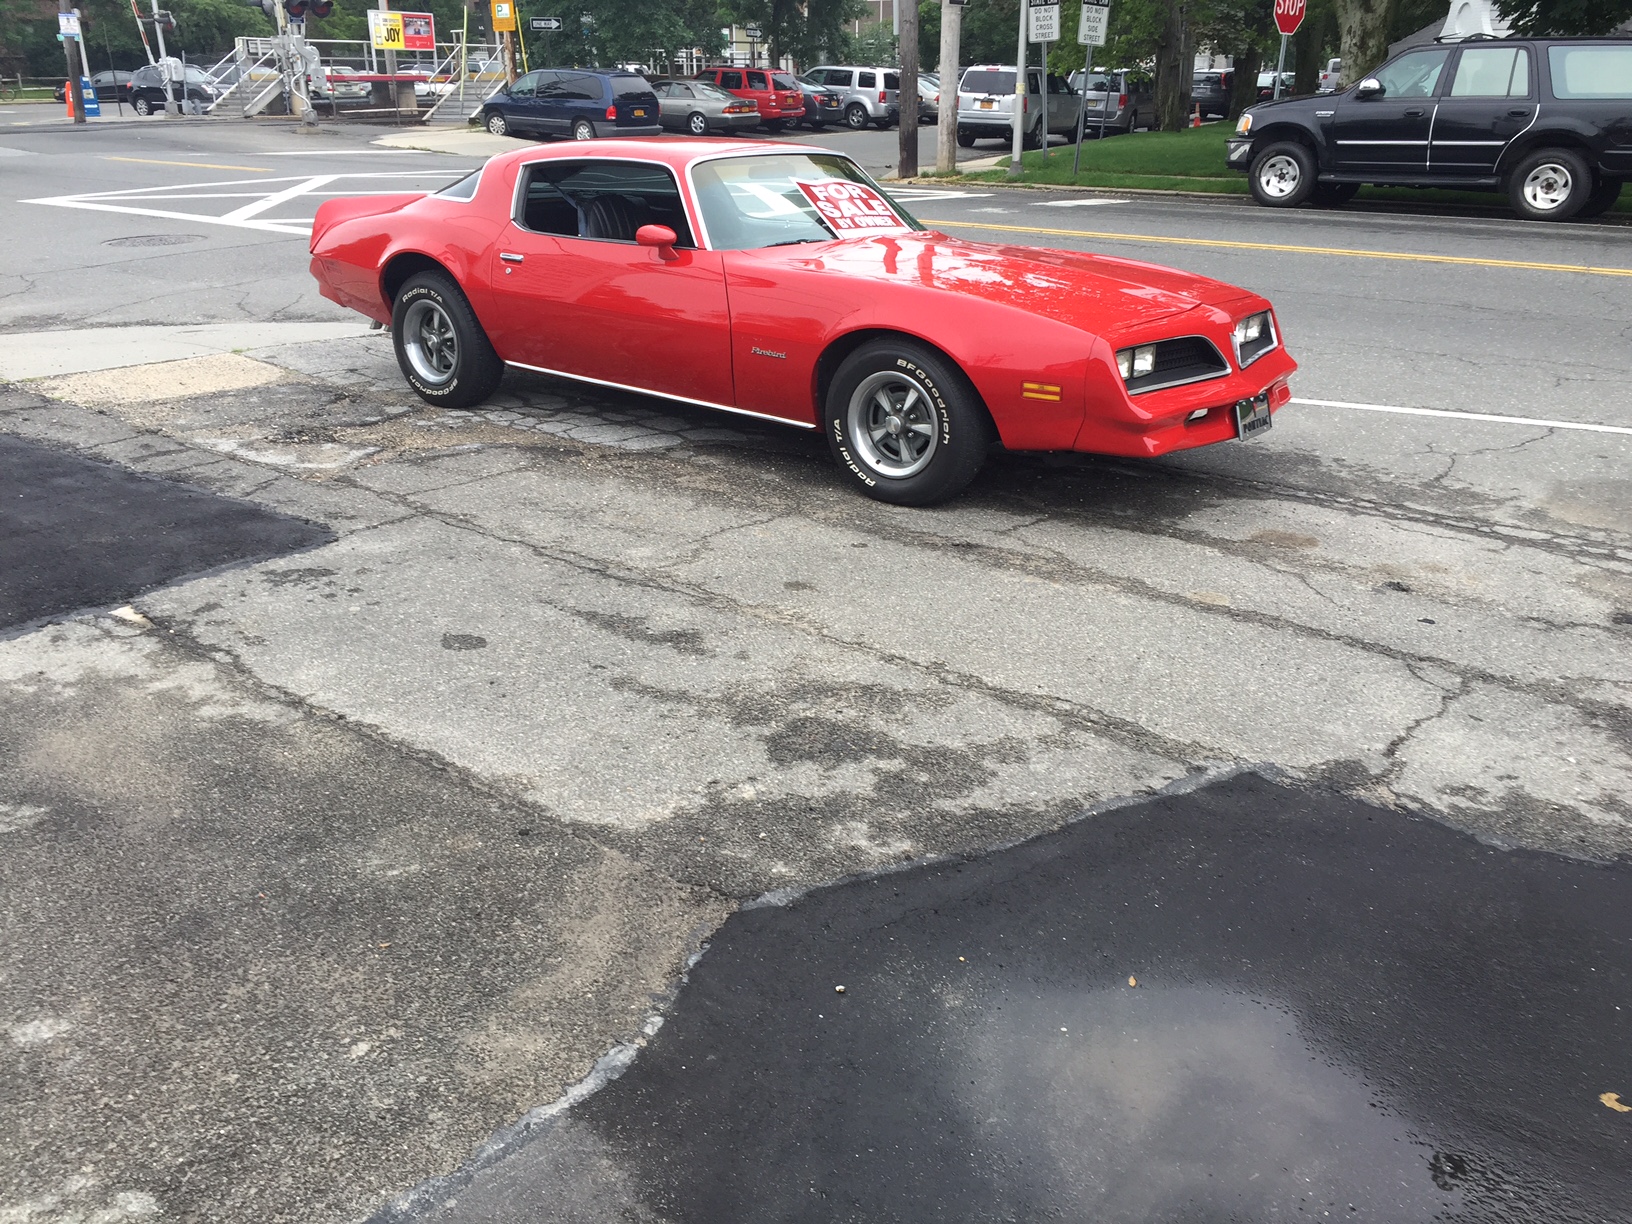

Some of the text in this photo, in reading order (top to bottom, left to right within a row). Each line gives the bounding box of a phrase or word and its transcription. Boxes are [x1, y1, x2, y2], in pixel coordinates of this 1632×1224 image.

[1277, 0, 1304, 15] STOP
[1086, 15, 1102, 23] BLOCK
[384, 27, 400, 42] JOY
[1036, 23, 1053, 31] CROSS
[1087, 25, 1099, 33] SIDE
[1083, 33, 1101, 42] STREET
[809, 184, 869, 201] FOR
[816, 200, 892, 218] SALE
[834, 216, 897, 229] BY OWNER
[402, 287, 443, 303] Radial T/A
[751, 346, 787, 359] Firebird
[409, 375, 458, 396] BFGoodrich
[896, 358, 950, 445] BFGoodrich
[1242, 415, 1269, 434] PONTIAC
[833, 418, 876, 487] Radial T/A
